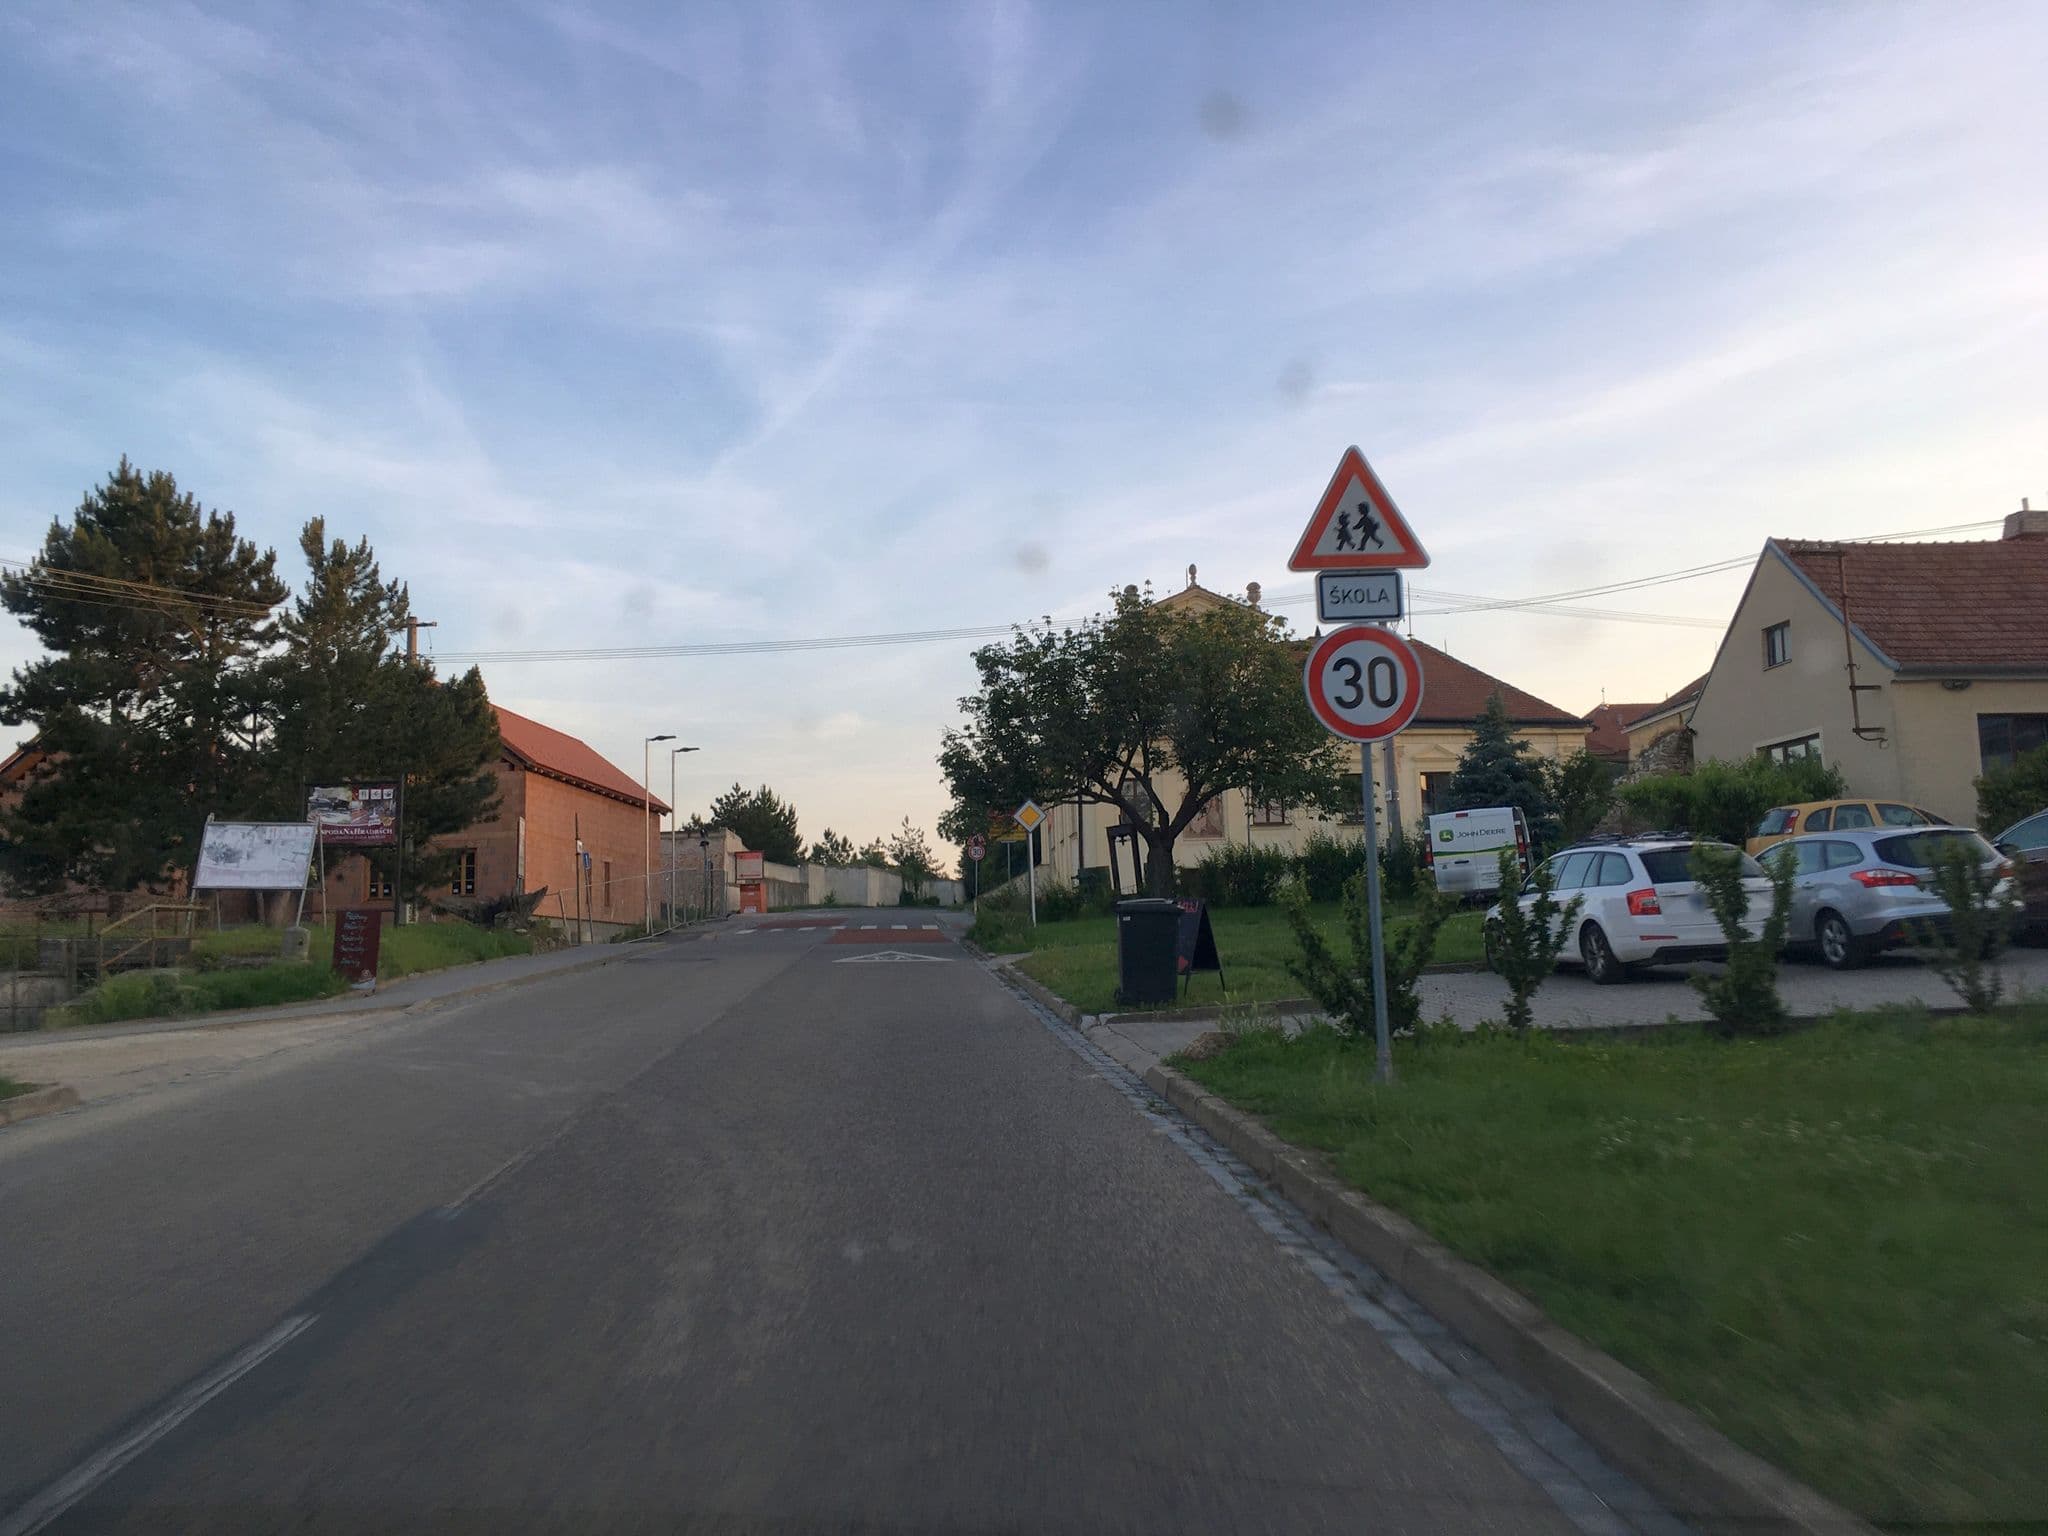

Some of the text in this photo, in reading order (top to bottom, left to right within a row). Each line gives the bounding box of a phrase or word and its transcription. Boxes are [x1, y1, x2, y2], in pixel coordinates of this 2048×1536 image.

[1329, 585, 1389, 605] ŠKOLA
[1332, 656, 1399, 710] 30
[1479, 828, 1506, 836] DEERE
